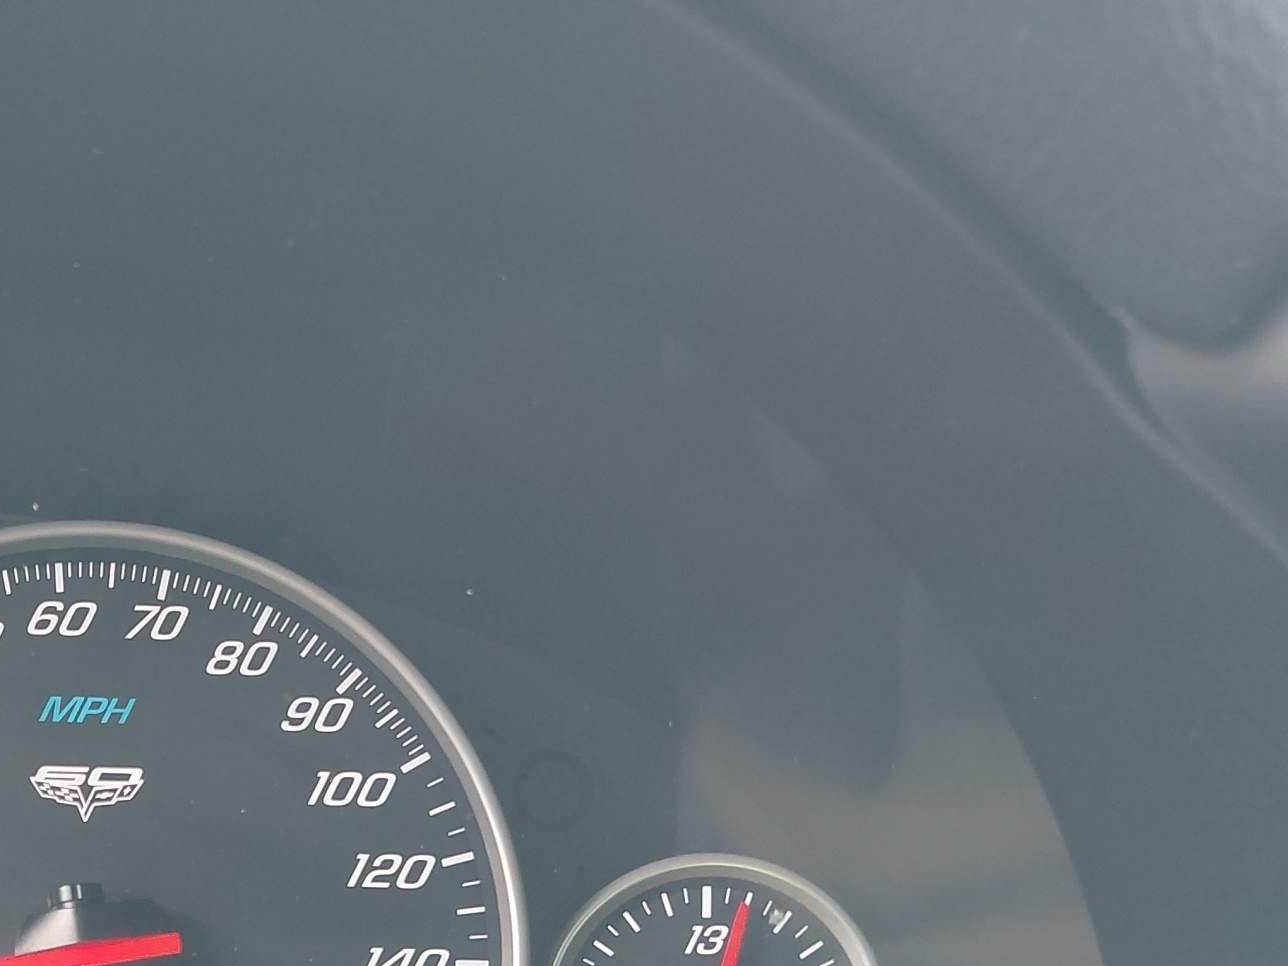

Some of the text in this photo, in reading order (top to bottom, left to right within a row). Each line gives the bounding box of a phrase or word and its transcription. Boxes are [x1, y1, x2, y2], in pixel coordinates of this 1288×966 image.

[27, 601, 98, 637] 60
[124, 604, 190, 641] 70
[206, 640, 279, 676] 80
[39, 694, 137, 725] MPH
[280, 696, 354, 733] 90
[307, 771, 397, 807] 100
[346, 853, 436, 889] 120
[684, 925, 729, 955] 13
